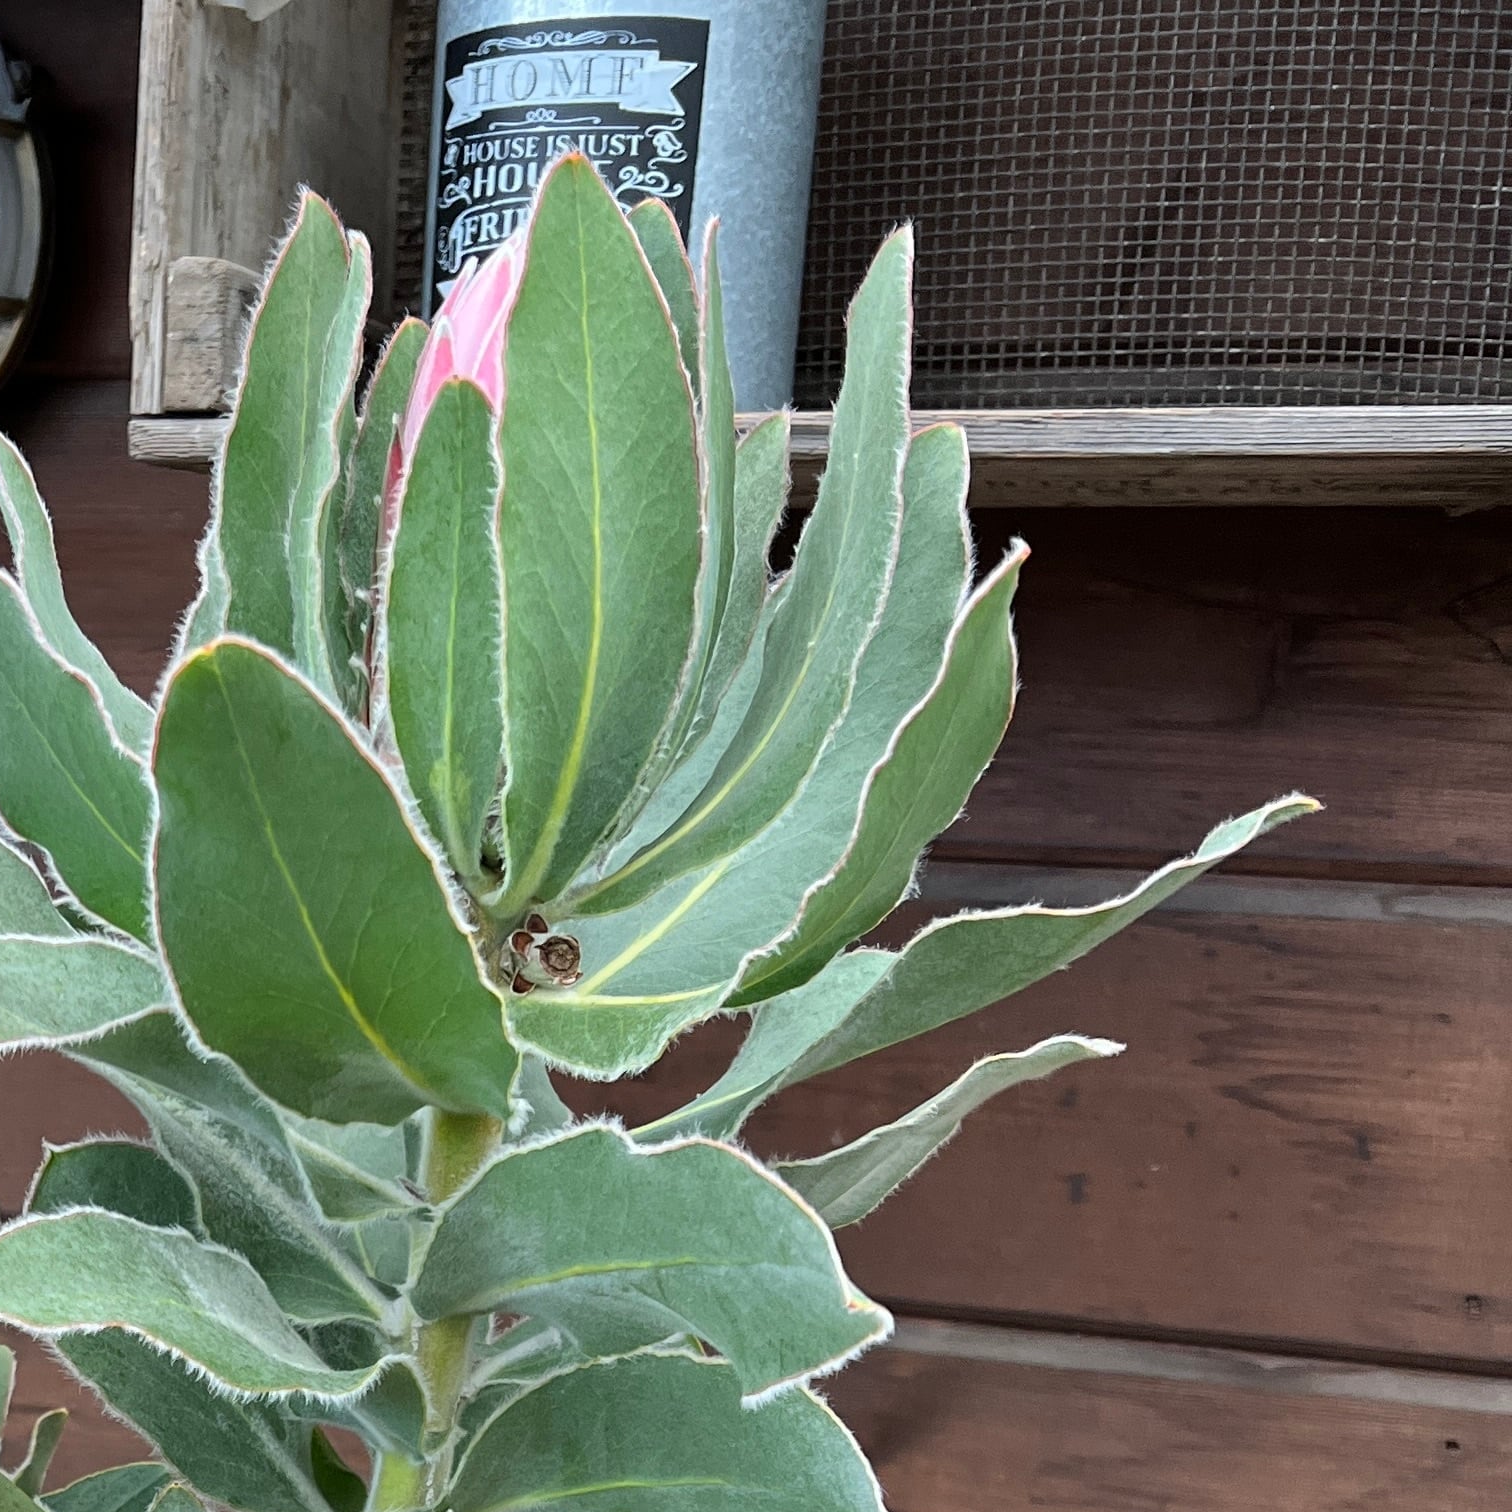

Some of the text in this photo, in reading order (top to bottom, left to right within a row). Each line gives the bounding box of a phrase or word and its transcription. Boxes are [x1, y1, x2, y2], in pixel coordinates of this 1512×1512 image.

[466, 55, 644, 105] HOME
[462, 137, 539, 165] HOUSE
[546, 135, 572, 157] IS
